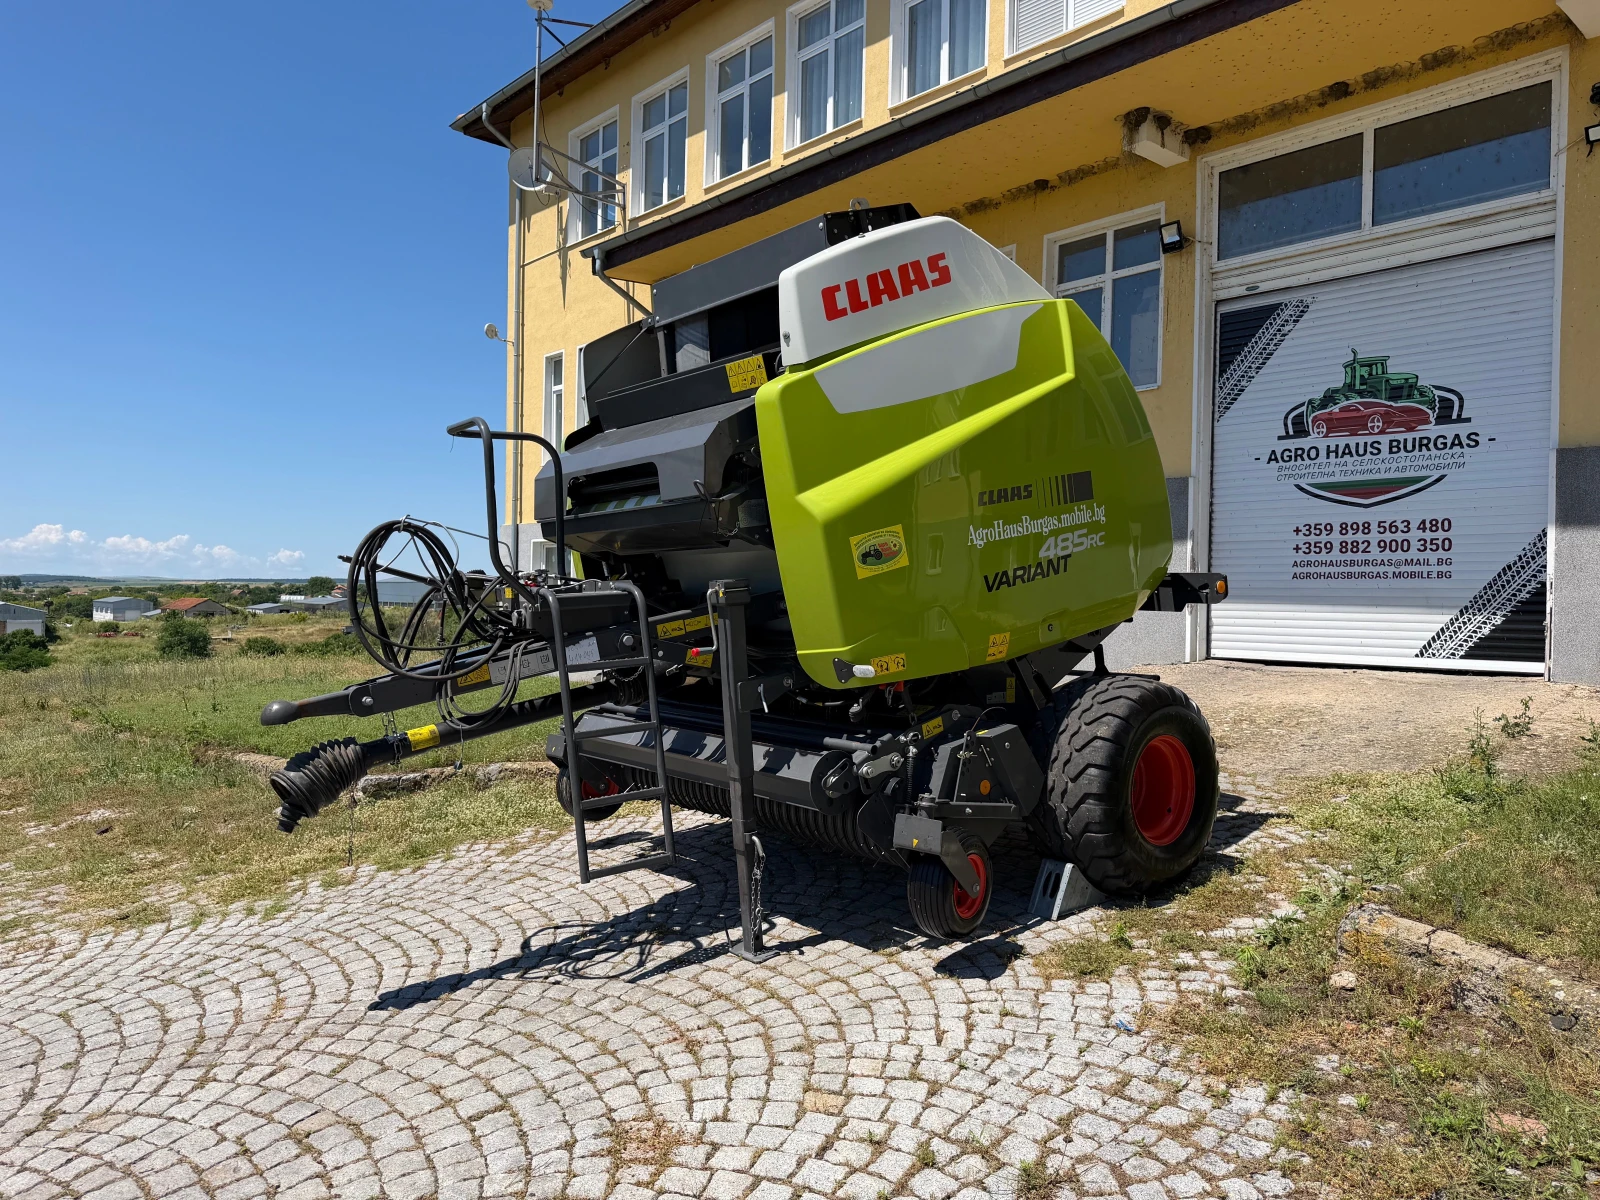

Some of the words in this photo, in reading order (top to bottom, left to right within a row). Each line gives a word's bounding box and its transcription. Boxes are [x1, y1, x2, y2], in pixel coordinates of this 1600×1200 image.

[821, 252, 952, 322] CLAAS
[1266, 446, 1320, 465] AGRO
[1326, 440, 1382, 460] HAUS
[1388, 432, 1480, 455] BURGAS
[1276, 461, 1331, 473] ВНОСИТЕЛ
[1333, 460, 1348, 469] НА
[1351, 451, 1465, 468] СЕЛСКОСТОПАНСКА
[1276, 470, 1336, 482] СТРОИТЕЛНА
[1338, 467, 1382, 477] ТЕХНИКА
[1383, 466, 1391, 474] И
[1393, 461, 1466, 474] АВТОМОБИЛИ
[977, 483, 1033, 507] CLAAS
[967, 502, 1106, 549] AgroHausBurgas.mobile.bg
[1293, 522, 1334, 537] +359
[1339, 521, 1371, 536] 898
[1377, 520, 1411, 534] 563
[1416, 518, 1452, 533] 480
[1293, 540, 1334, 555] +359
[1339, 539, 1371, 554] 882
[1377, 538, 1411, 553] 900
[1416, 537, 1453, 552] 350
[983, 554, 1072, 593] VARIANT
[1291, 557, 1453, 568] AGROHAUSBURGAS@MAIL.BG
[1291, 570, 1453, 580] AGROHAUSBURGAS.MOBILE.BG
